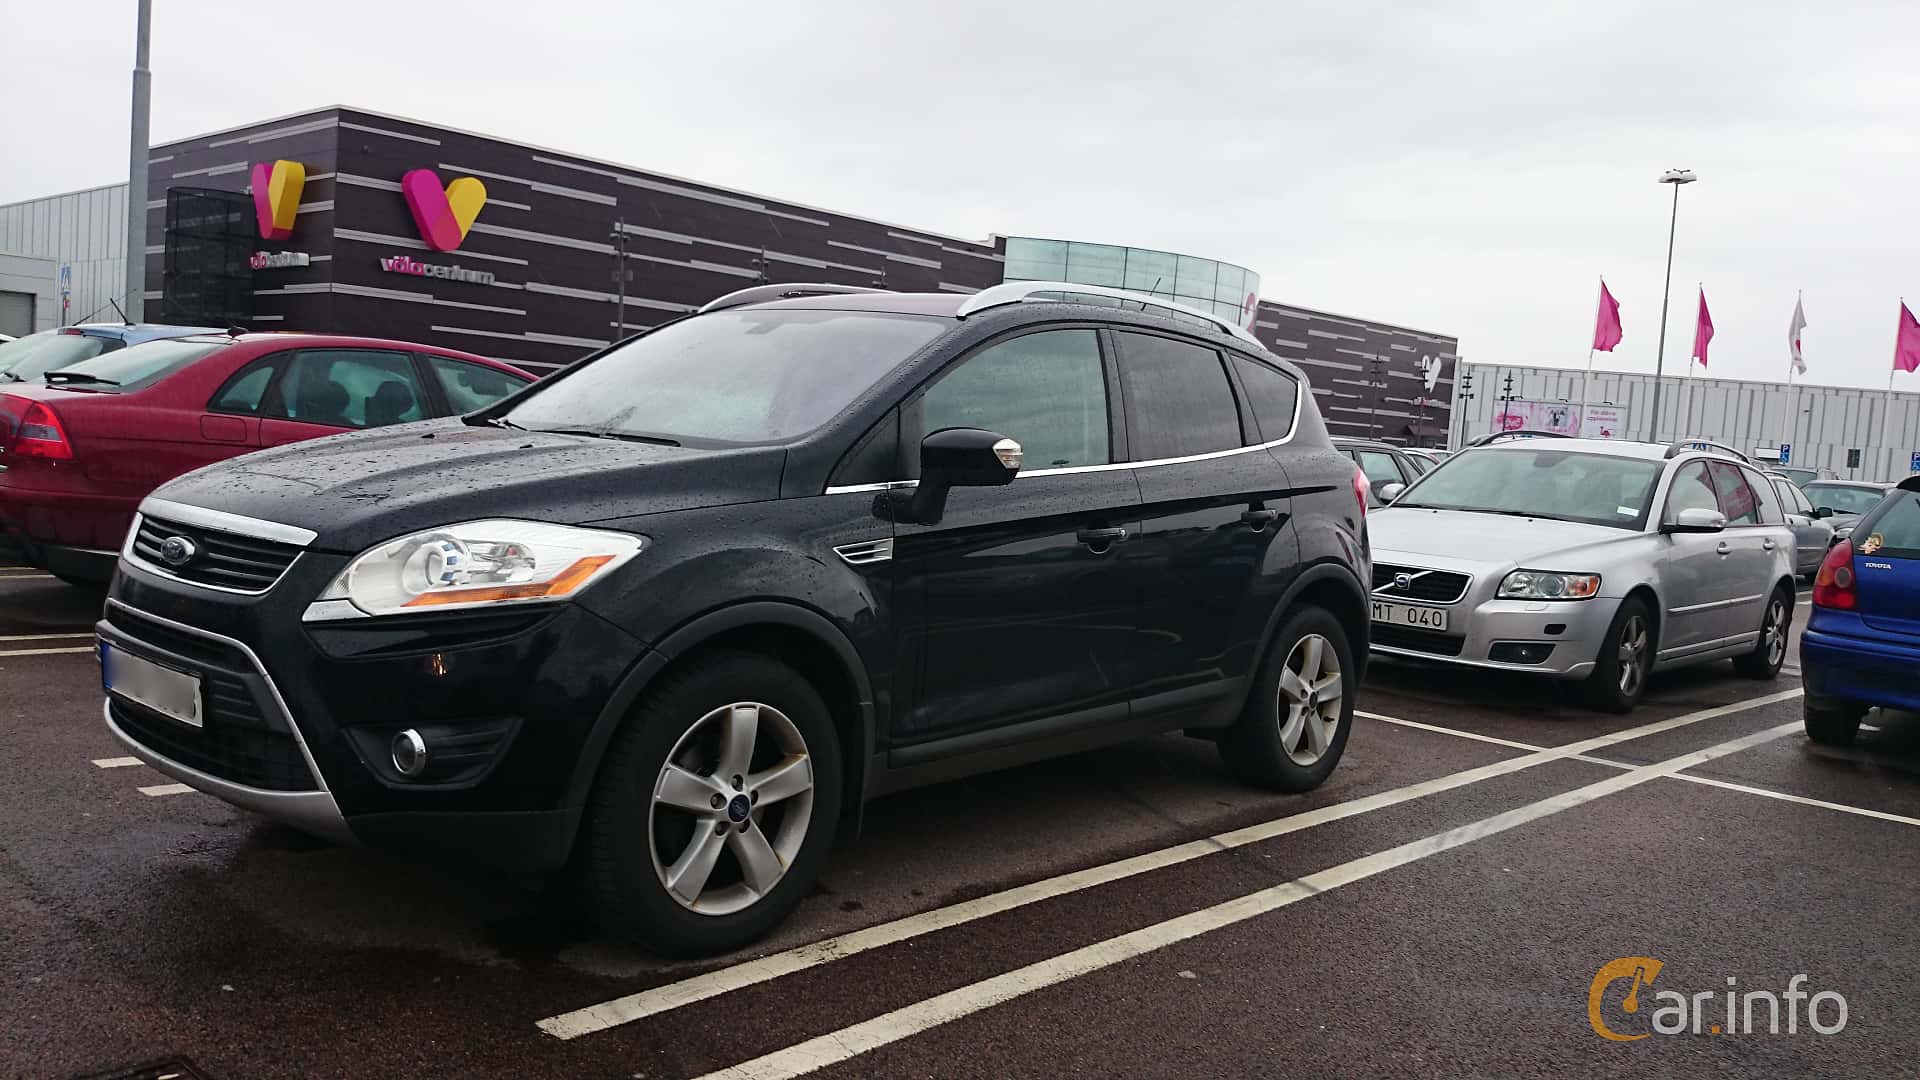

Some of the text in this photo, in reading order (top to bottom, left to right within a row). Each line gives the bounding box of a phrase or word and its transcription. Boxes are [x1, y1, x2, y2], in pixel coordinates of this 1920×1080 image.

[1864, 562, 1891, 570] TOYOTA
[1372, 602, 1442, 627] MT 040
